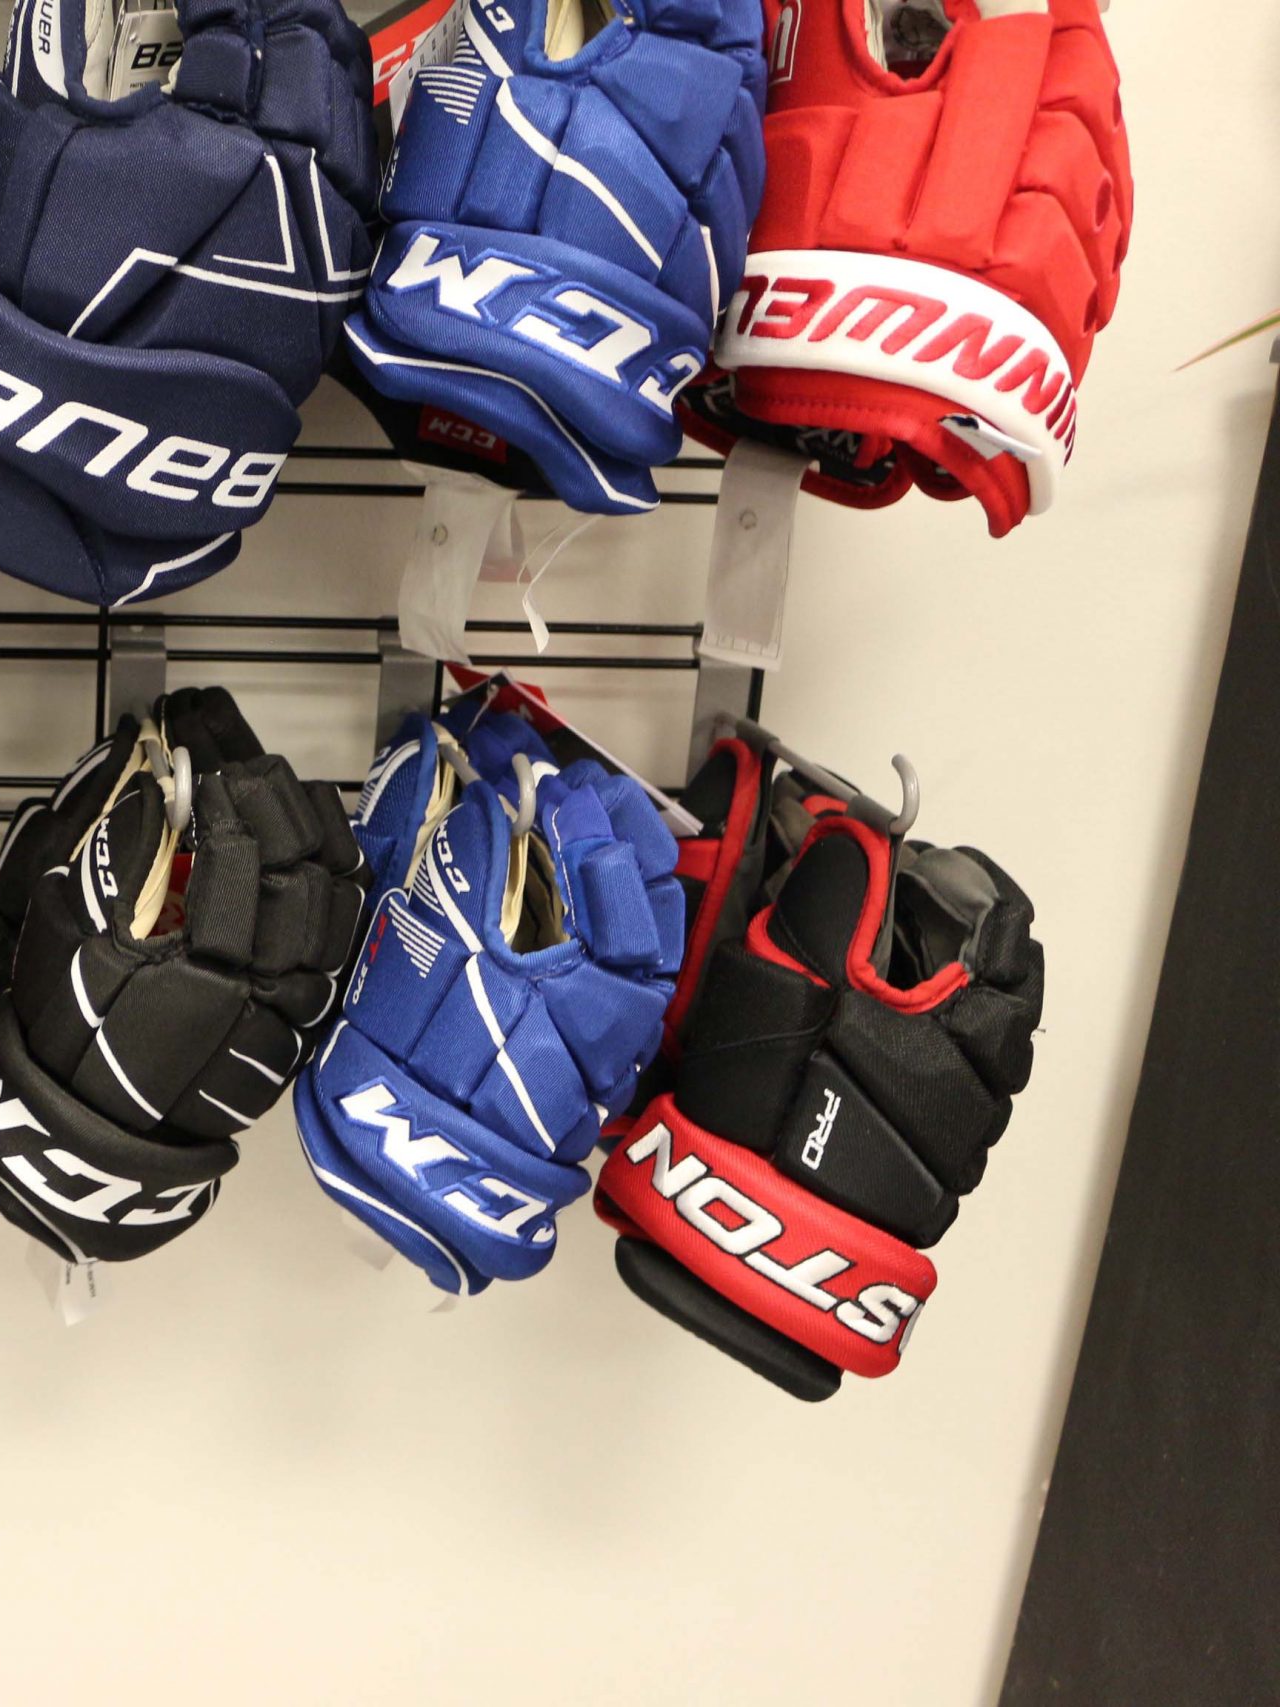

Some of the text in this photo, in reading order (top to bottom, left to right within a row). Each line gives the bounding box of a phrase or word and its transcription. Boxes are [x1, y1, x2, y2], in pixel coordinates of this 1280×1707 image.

[386, 234, 702, 419] CCM
[427, 416, 496, 449] CCM
[96, 817, 119, 898] CCM
[340, 1083, 555, 1243] CM
[801, 1087, 842, 1171] PRO
[625, 1121, 925, 1354] STON
